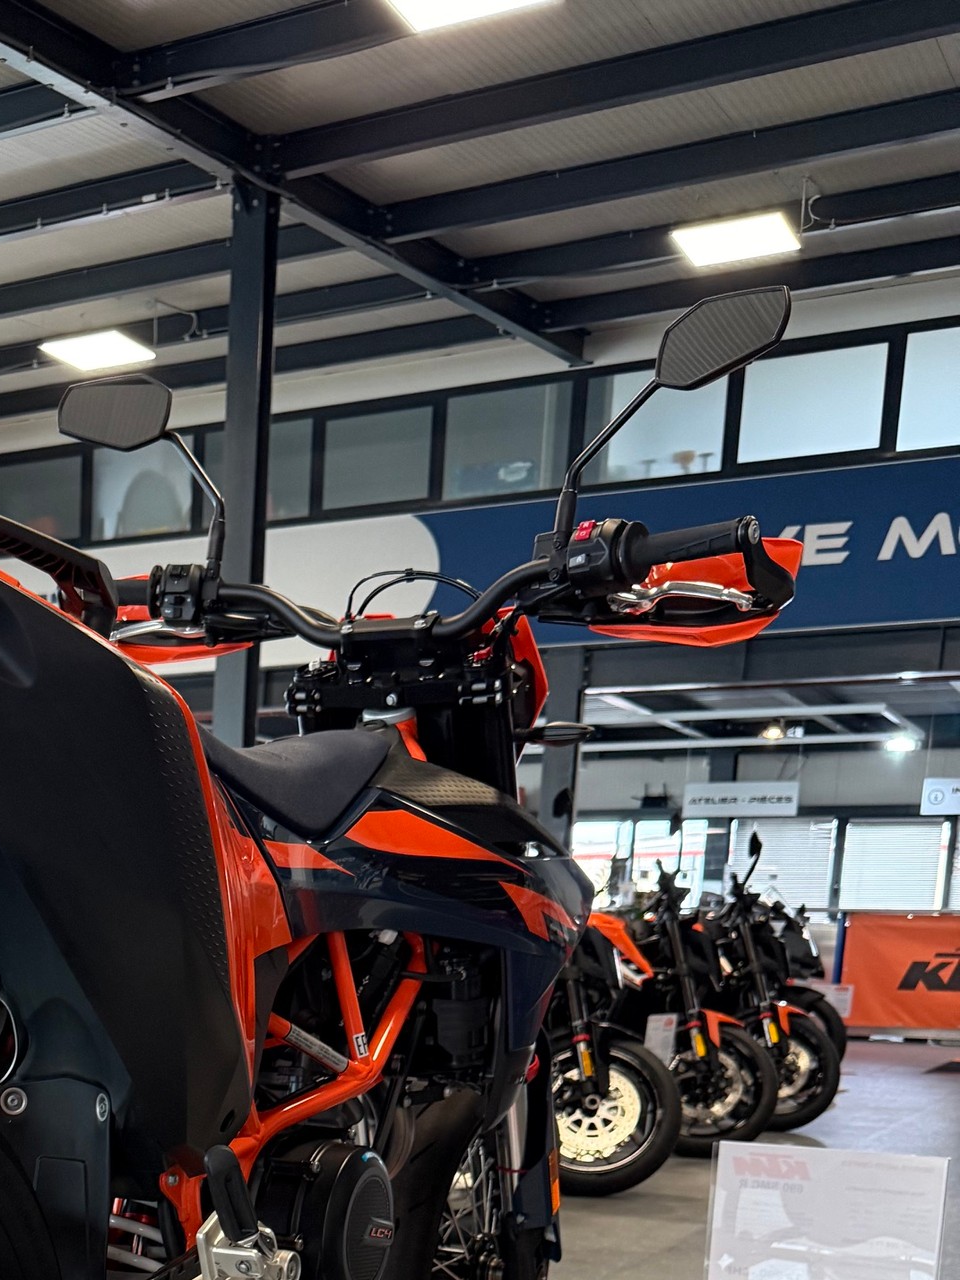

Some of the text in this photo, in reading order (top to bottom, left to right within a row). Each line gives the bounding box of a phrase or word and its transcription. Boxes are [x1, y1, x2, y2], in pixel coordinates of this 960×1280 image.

[778, 512, 960, 566] E M
[688, 795, 737, 806] ATELIER
[371, 1228, 392, 1239] LC4
